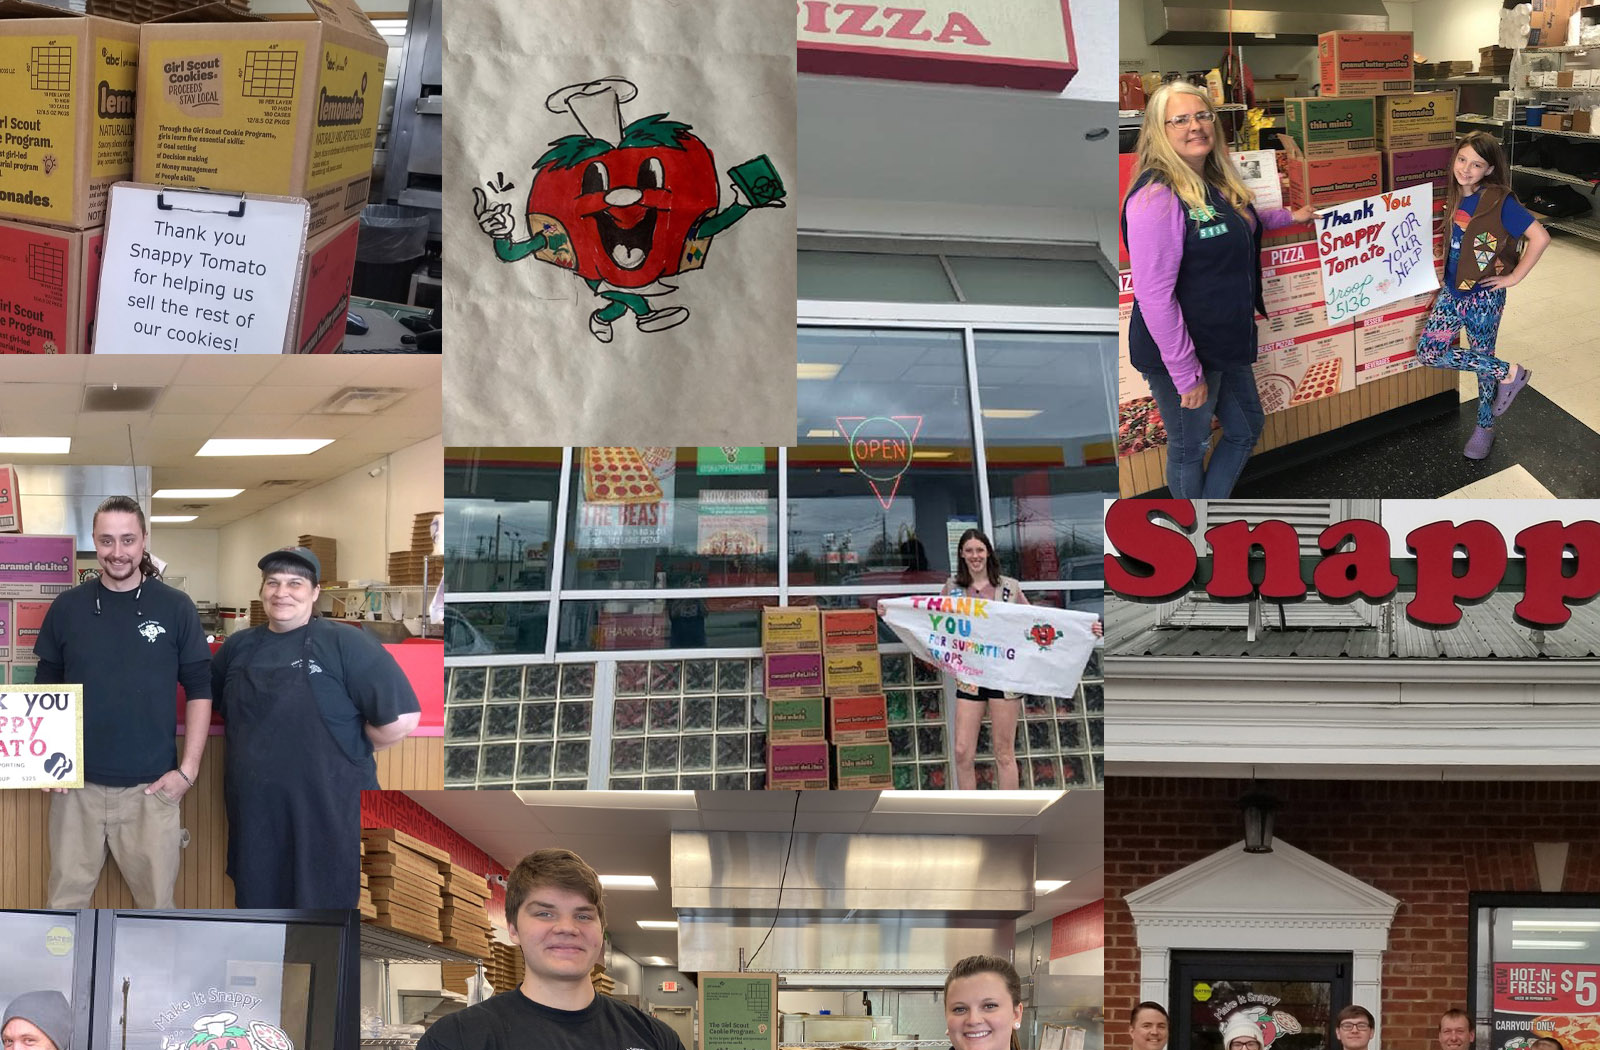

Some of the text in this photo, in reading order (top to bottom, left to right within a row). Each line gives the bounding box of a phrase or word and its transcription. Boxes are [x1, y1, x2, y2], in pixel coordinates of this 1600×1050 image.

[9, 117, 41, 132] Scout
[1320, 193, 1411, 231] Thank You
[1392, 212, 1421, 241] FOR
[154, 220, 246, 248] Thank you
[1318, 222, 1385, 260] Snappy
[130, 243, 267, 277] Snappy Tomato
[1270, 246, 1305, 265] PIZZA
[1324, 246, 1385, 277] Tomato
[1382, 235, 1422, 273] YOUR
[1396, 249, 1423, 286] HELP
[133, 269, 254, 301] for helping us
[1326, 274, 1375, 307] Troop
[127, 293, 256, 327] sell the rest of
[1330, 293, 1370, 320] 5136
[133, 321, 239, 352] our cookies!
[857, 438, 906, 459] OPEN
[911, 595, 989, 619] THANK
[929, 614, 972, 637] YOU
[23, 693, 70, 715] YOU
[1509, 968, 1556, 982] HOT-N-
[1509, 980, 1556, 995] FRESH
[1560, 969, 1597, 1006] $5
[1495, 1020, 1556, 1032] CARRYOUT ONLY
